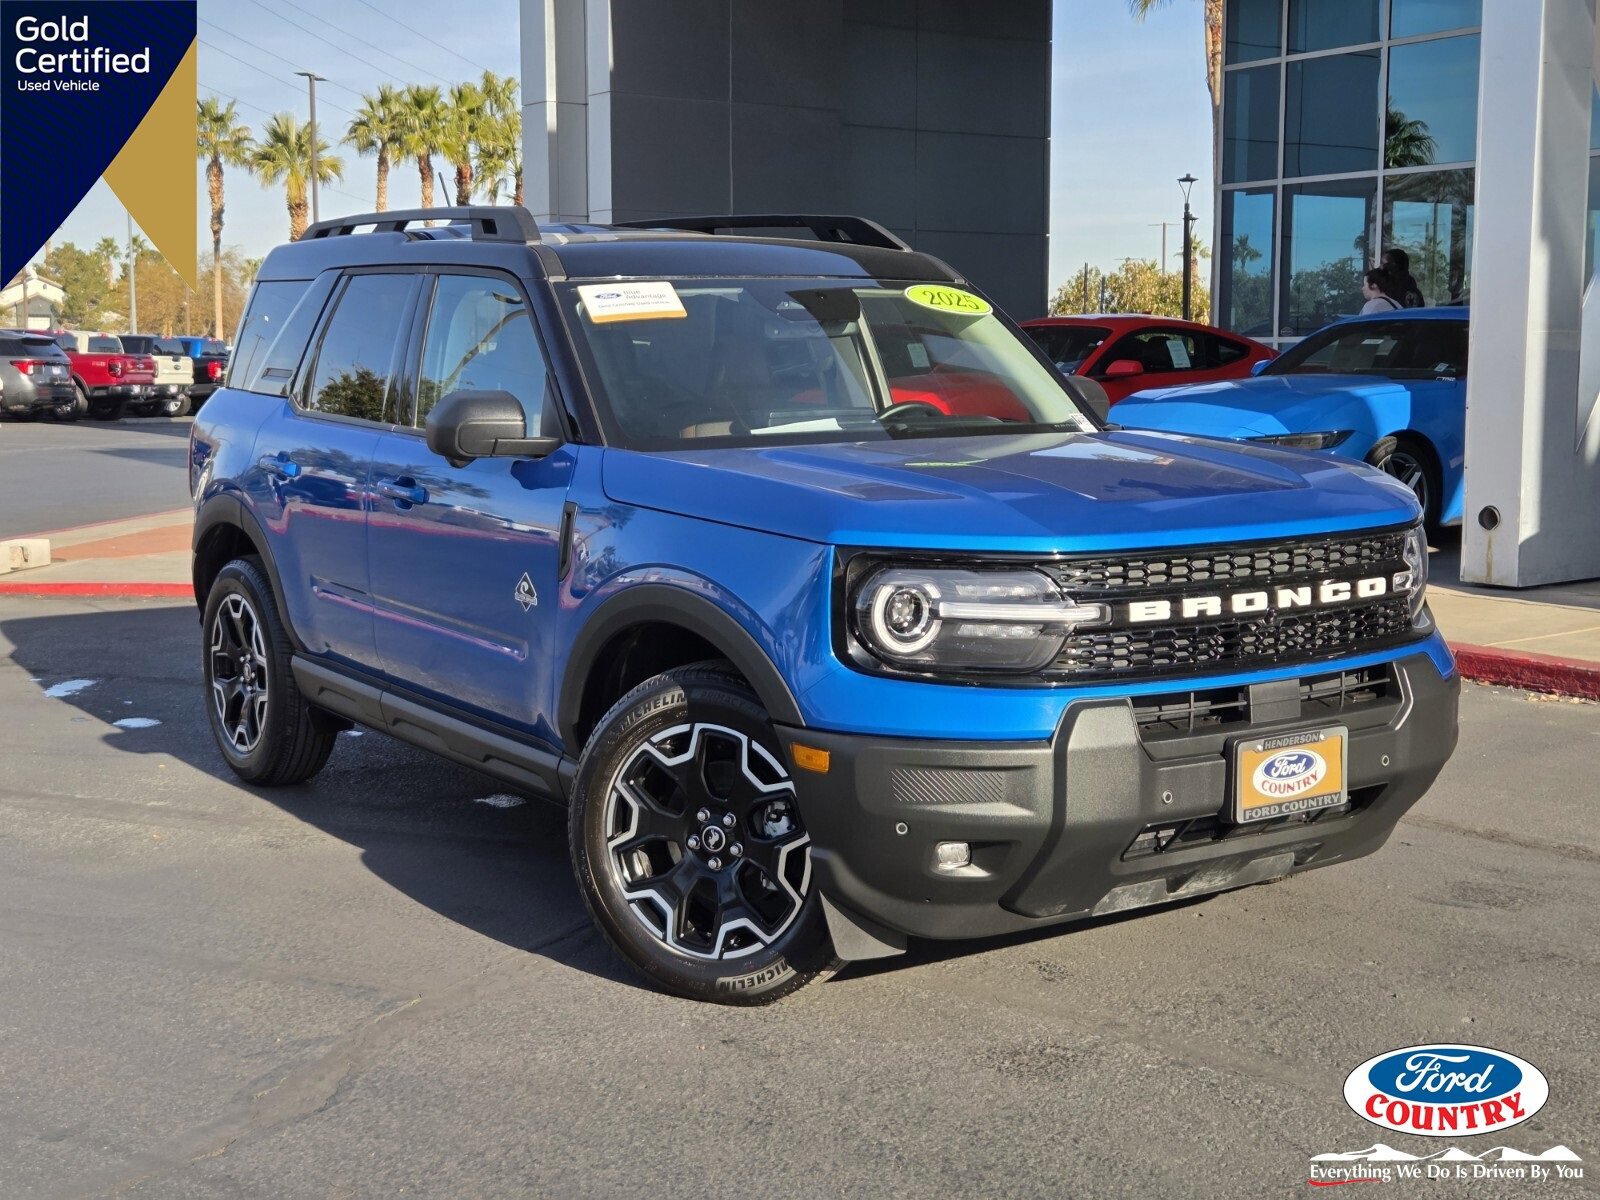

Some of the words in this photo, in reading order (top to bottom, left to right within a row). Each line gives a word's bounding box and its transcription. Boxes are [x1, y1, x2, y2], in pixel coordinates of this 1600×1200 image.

[922, 290, 980, 310] 2025
[1129, 577, 1386, 622] BRONCO
[621, 692, 688, 730] MICHELIN
[1264, 732, 1320, 750] HENDERSON
[1271, 754, 1307, 778] Ford
[1261, 769, 1318, 794] COUNTRY
[1245, 804, 1280, 820] FORD
[1282, 793, 1340, 813] COUNTRY
